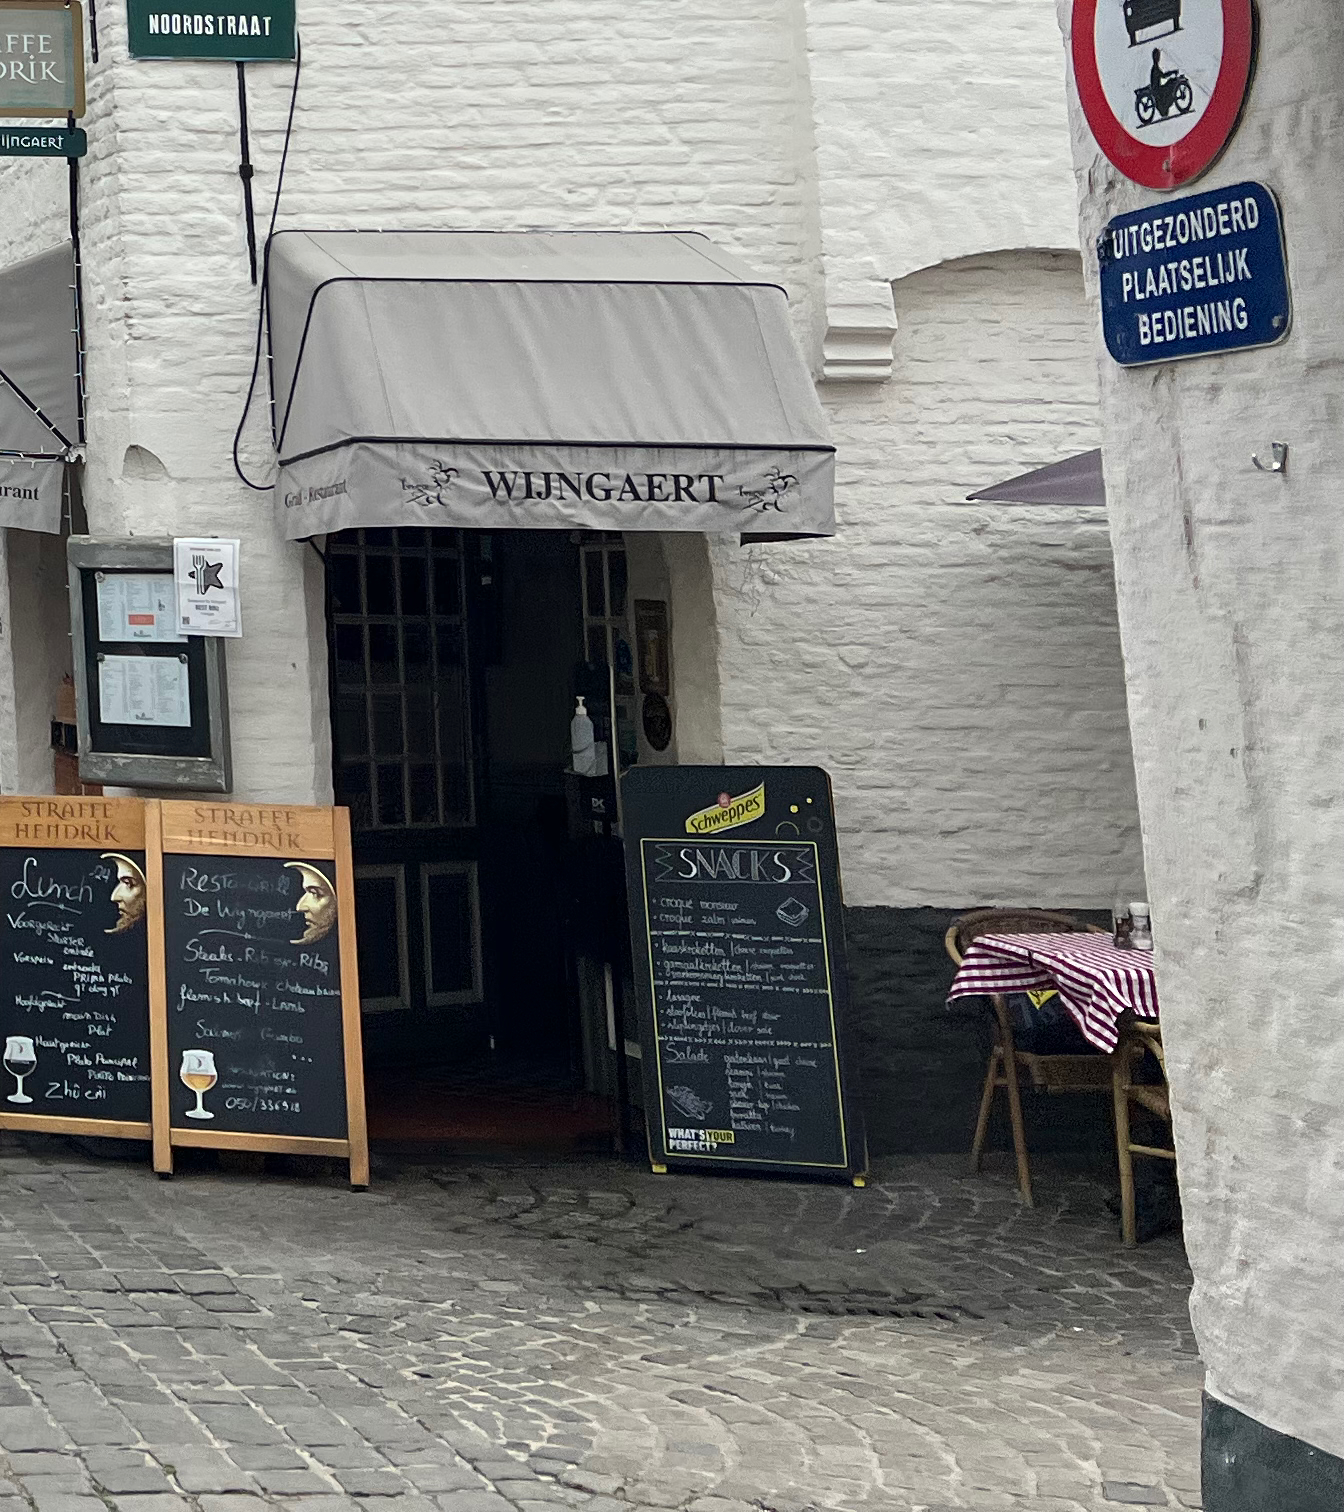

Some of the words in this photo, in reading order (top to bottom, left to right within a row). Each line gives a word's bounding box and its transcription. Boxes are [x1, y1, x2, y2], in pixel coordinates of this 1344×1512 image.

[148, 13, 272, 37] NOORDSTRAAT
[1112, 196, 1260, 260] UITGEZONDERD
[1122, 247, 1253, 303] PLAATSELIJK
[1138, 297, 1249, 346] BEDIENING
[480, 469, 725, 504] WIJNGAERT
[21, 801, 113, 820] STRAFFE
[194, 807, 299, 828] STRAFFE
[690, 796, 761, 834] Schweppes
[15, 820, 120, 843] HENDRIK
[187, 824, 306, 851] HENDRIK
[678, 848, 792, 883] SNACKS
[12, 857, 93, 904] Lunch
[184, 898, 210, 917] De
[659, 913, 694, 929] croque
[184, 938, 234, 963] Steaks
[668, 1128, 705, 1141] WHAT'S
[707, 1131, 733, 1142] YOUR
